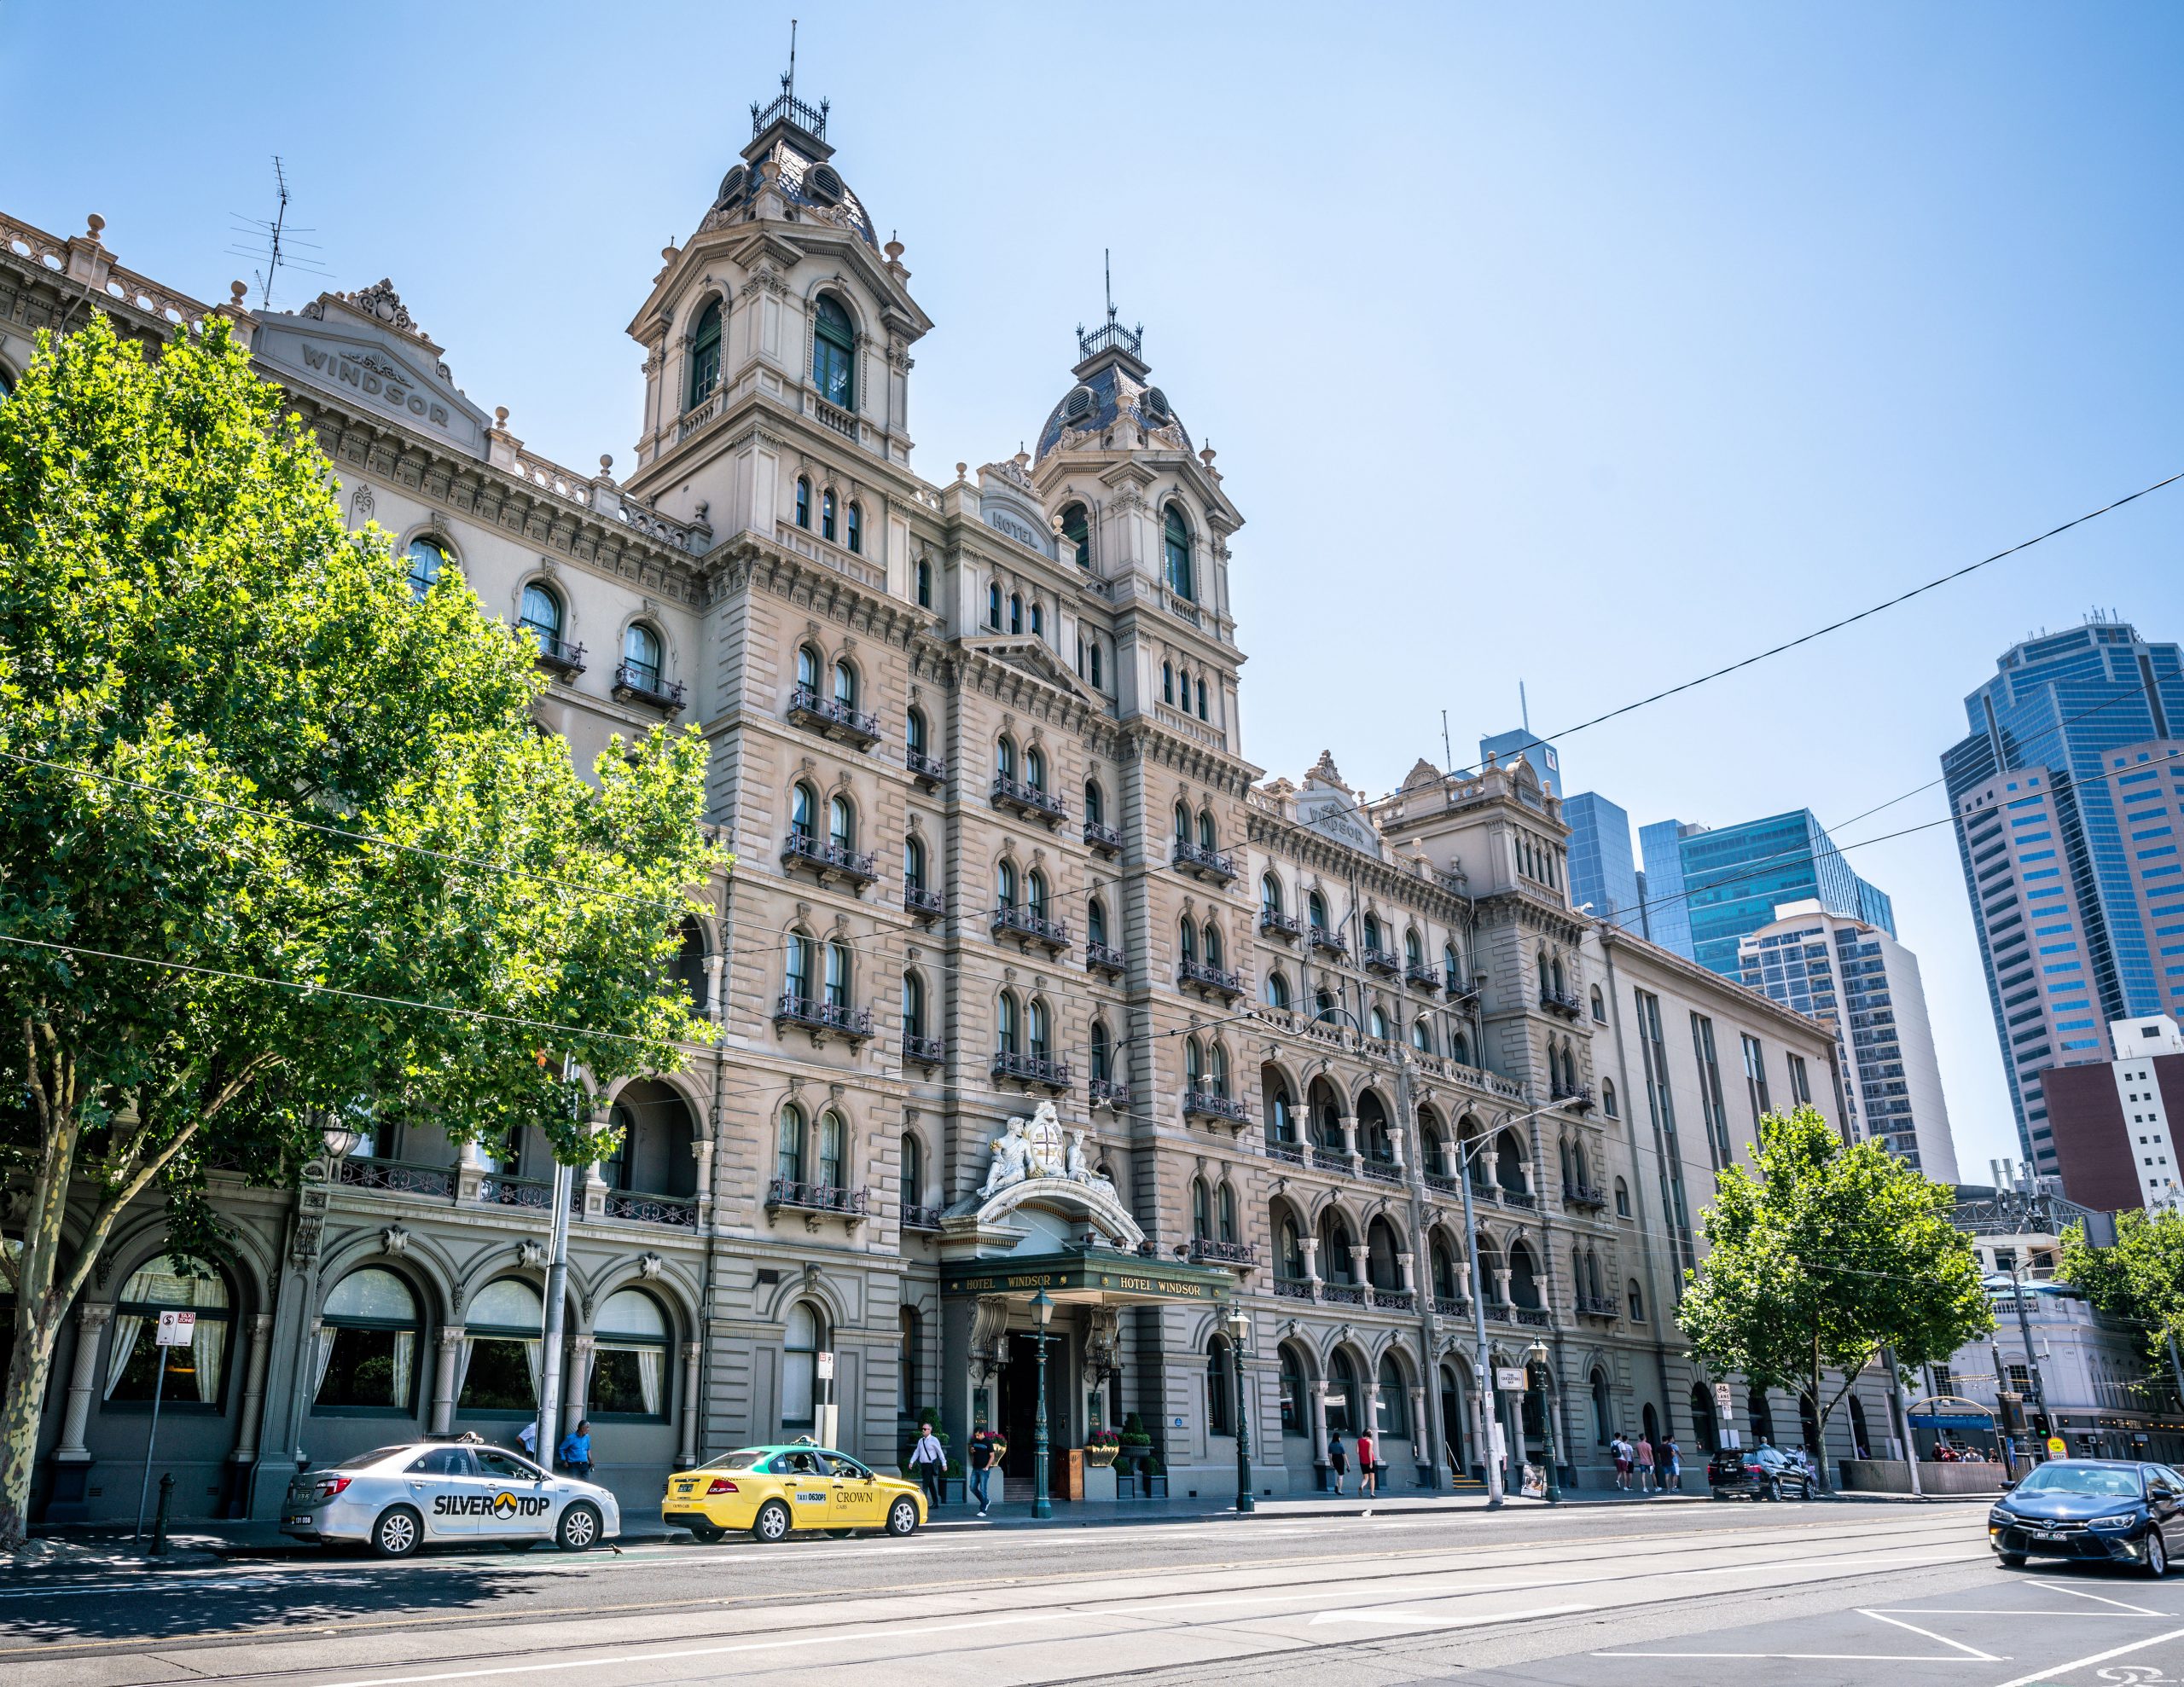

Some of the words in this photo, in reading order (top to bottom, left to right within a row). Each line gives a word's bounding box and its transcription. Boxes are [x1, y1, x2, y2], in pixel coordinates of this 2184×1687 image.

[302, 344, 449, 426] WINDSOR
[992, 511, 1038, 549] HOTEL
[1309, 807, 1364, 844] WINDSOR
[966, 1278, 996, 1290] HOTEL
[1008, 1274, 1051, 1288] WINDSOR
[1120, 1277, 1153, 1290] HOTEL
[1158, 1281, 1200, 1296] WINDSOR
[433, 1494, 494, 1516] SILVER
[518, 1496, 550, 1516] TOP
[836, 1492, 873, 1503] CROWN
